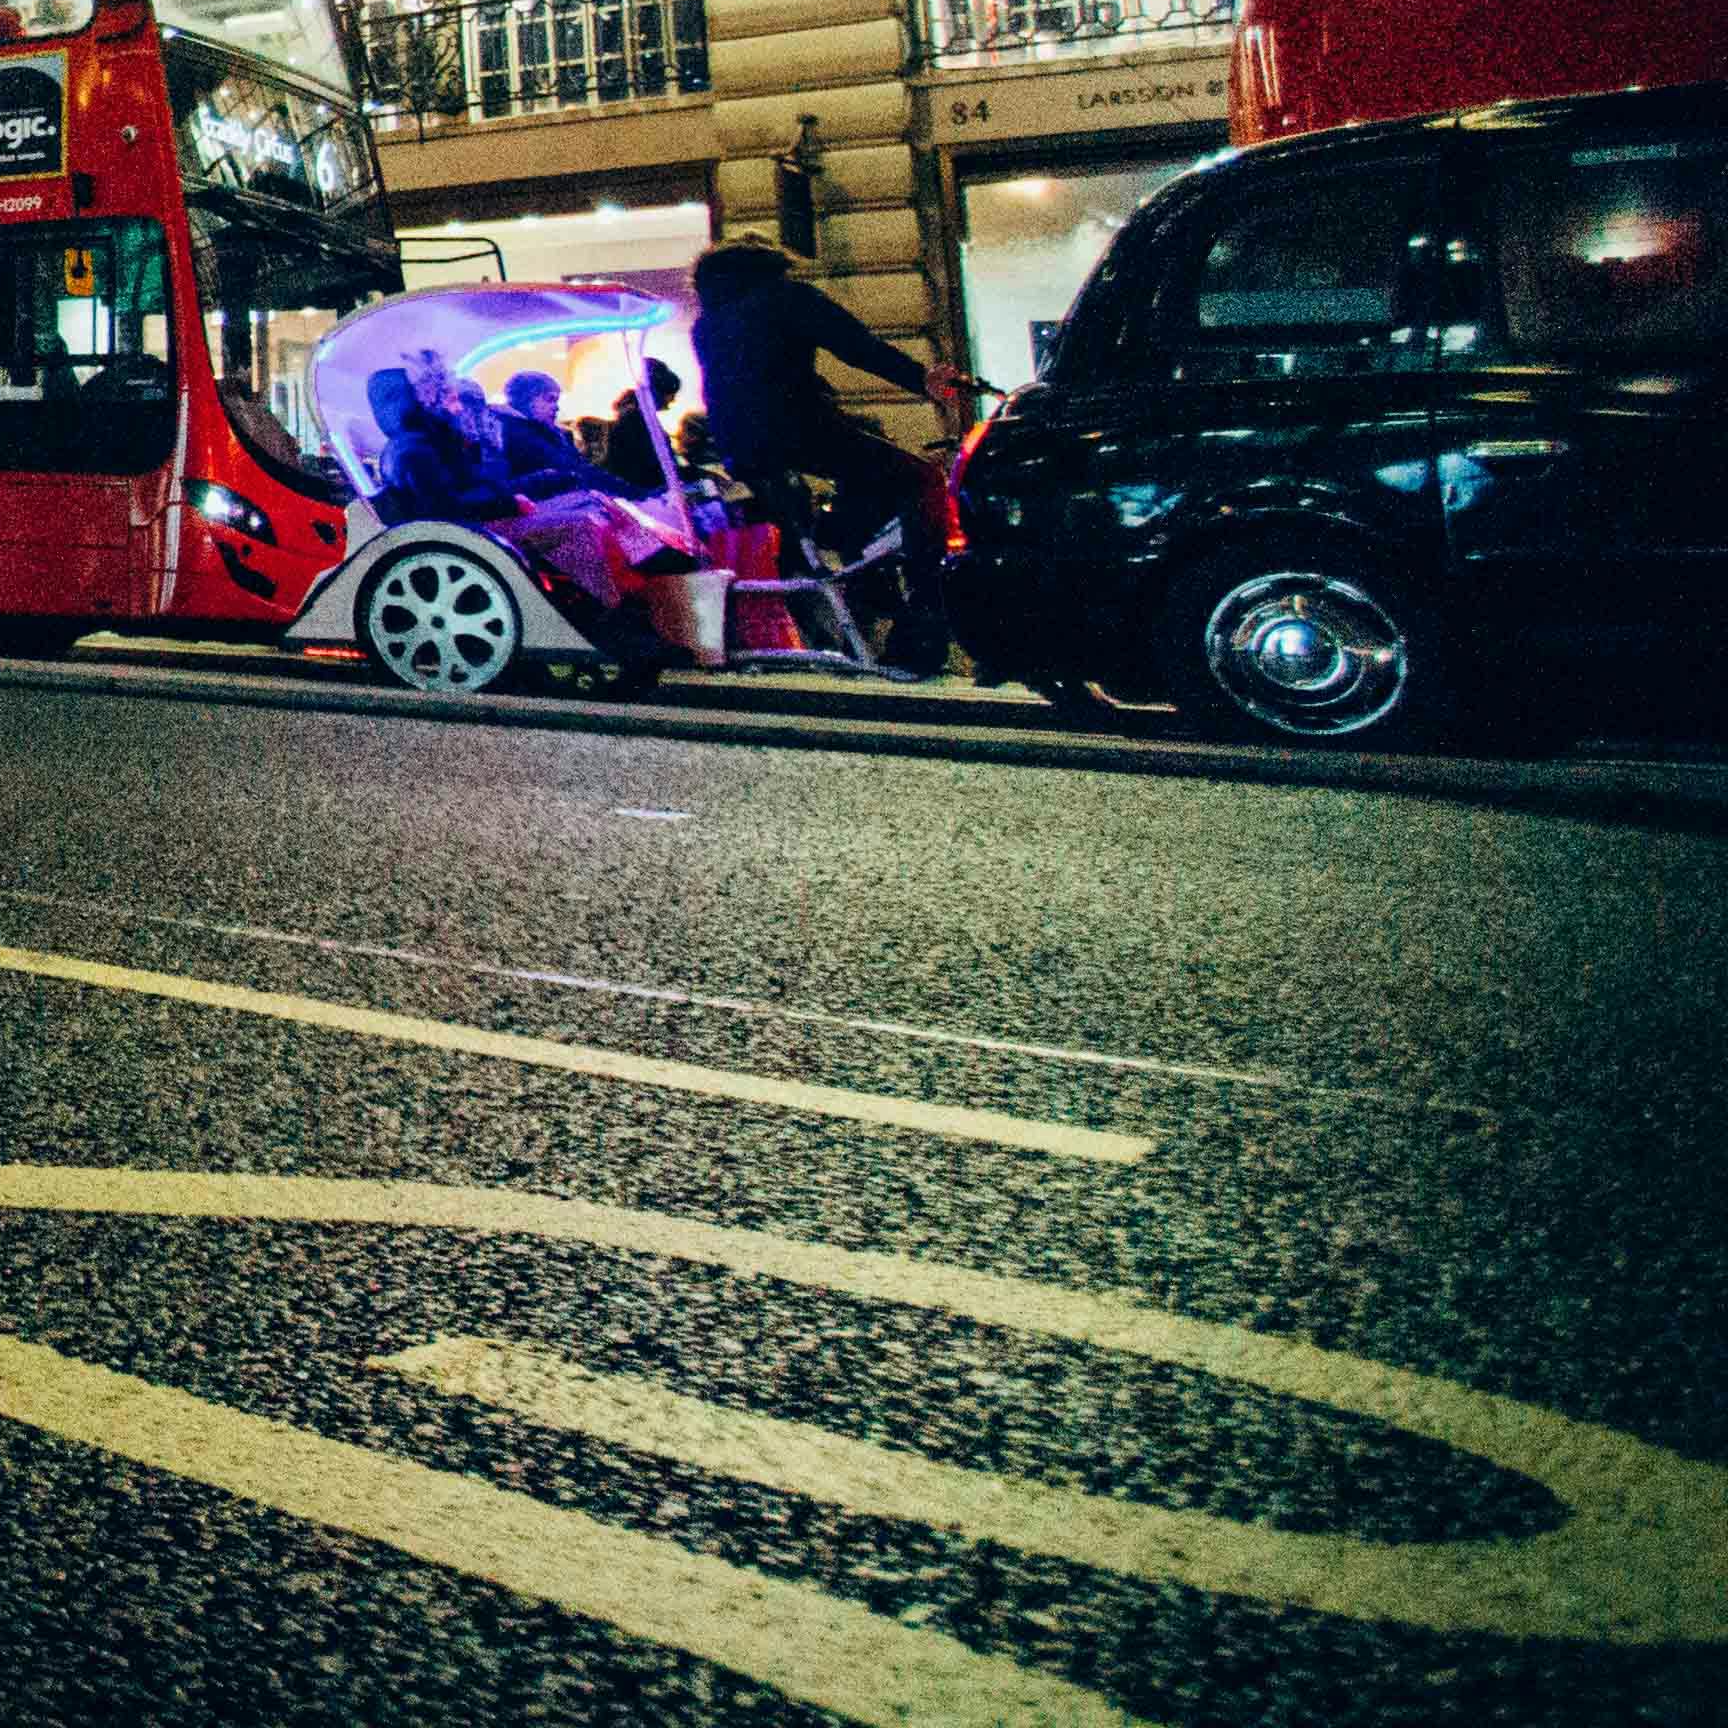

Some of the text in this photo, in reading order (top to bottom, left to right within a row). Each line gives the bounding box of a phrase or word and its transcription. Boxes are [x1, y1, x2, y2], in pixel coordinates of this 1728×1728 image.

[1077, 82, 1195, 110] LARSSON
[950, 98, 991, 125] 84
[317, 138, 339, 194] 6
